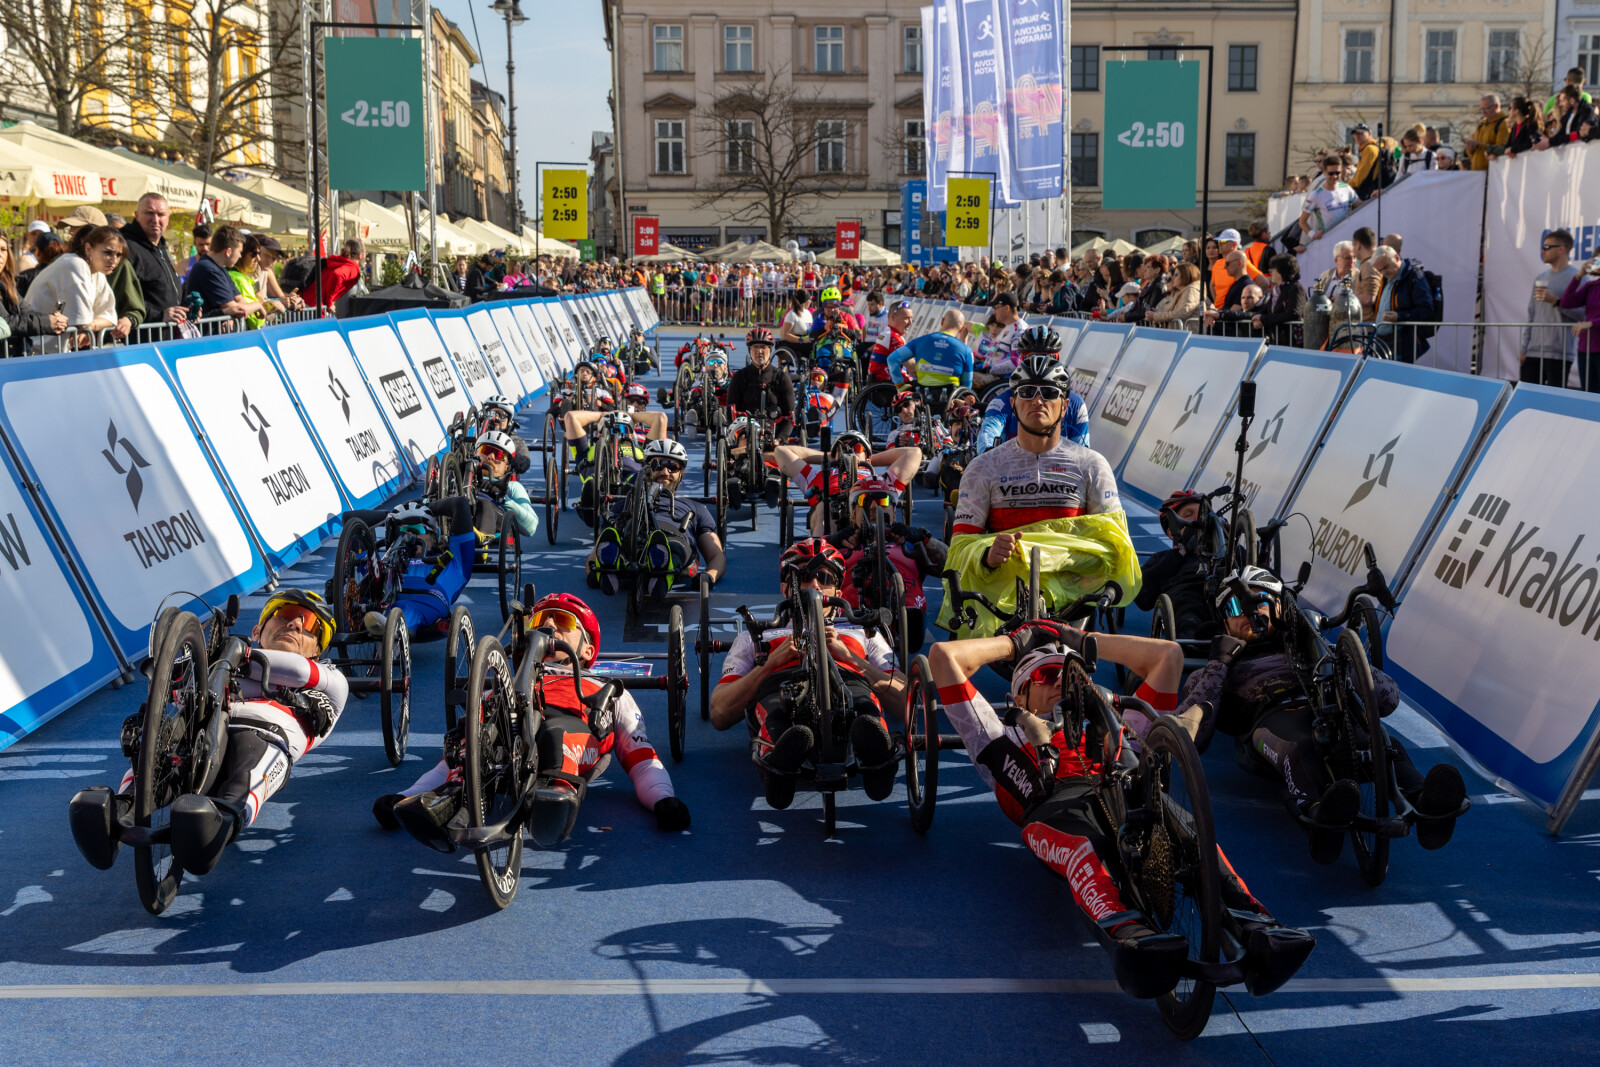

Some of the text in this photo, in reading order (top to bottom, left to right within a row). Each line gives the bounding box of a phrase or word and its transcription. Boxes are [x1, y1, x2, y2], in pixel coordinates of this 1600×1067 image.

[341, 100, 411, 127] <2:50
[1118, 121, 1185, 148] <2:50
[53, 172, 89, 197] ŻYWIEC
[552, 187, 578, 199] 2:50
[552, 209, 578, 221] 2:59
[956, 195, 981, 207] 2:50
[955, 217, 980, 229] 2:59
[381, 374, 420, 415] OSHEE
[1104, 384, 1142, 423] OSHEE
[345, 428, 382, 462] TAURON
[1149, 439, 1185, 471] TAURON
[261, 462, 312, 507] TAURON
[1222, 471, 1262, 511] TARON
[123, 509, 206, 570] TAURON
[1308, 517, 1367, 577] TAURON
